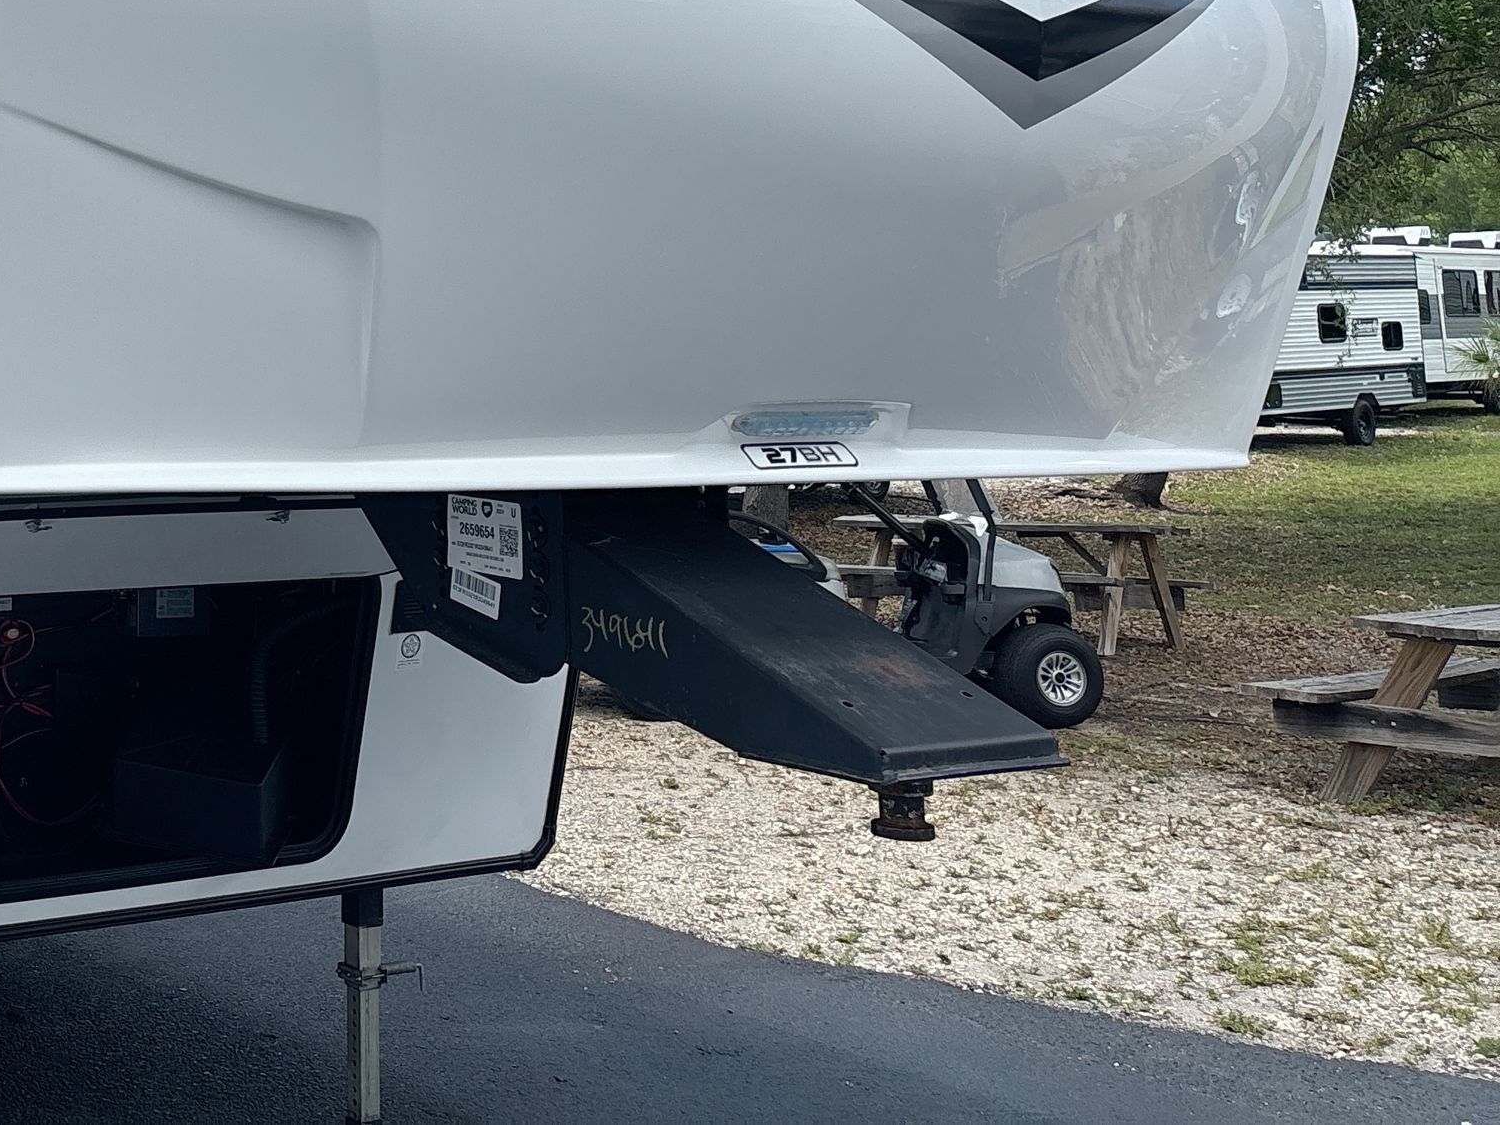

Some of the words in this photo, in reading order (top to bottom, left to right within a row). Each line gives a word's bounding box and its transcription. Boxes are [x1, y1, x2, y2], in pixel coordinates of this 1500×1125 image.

[761, 446, 843, 464] 27BH
[451, 496, 478, 507] CAMPING
[451, 504, 478, 516] WORLD
[510, 507, 517, 518] U
[459, 522, 495, 539] 2659654
